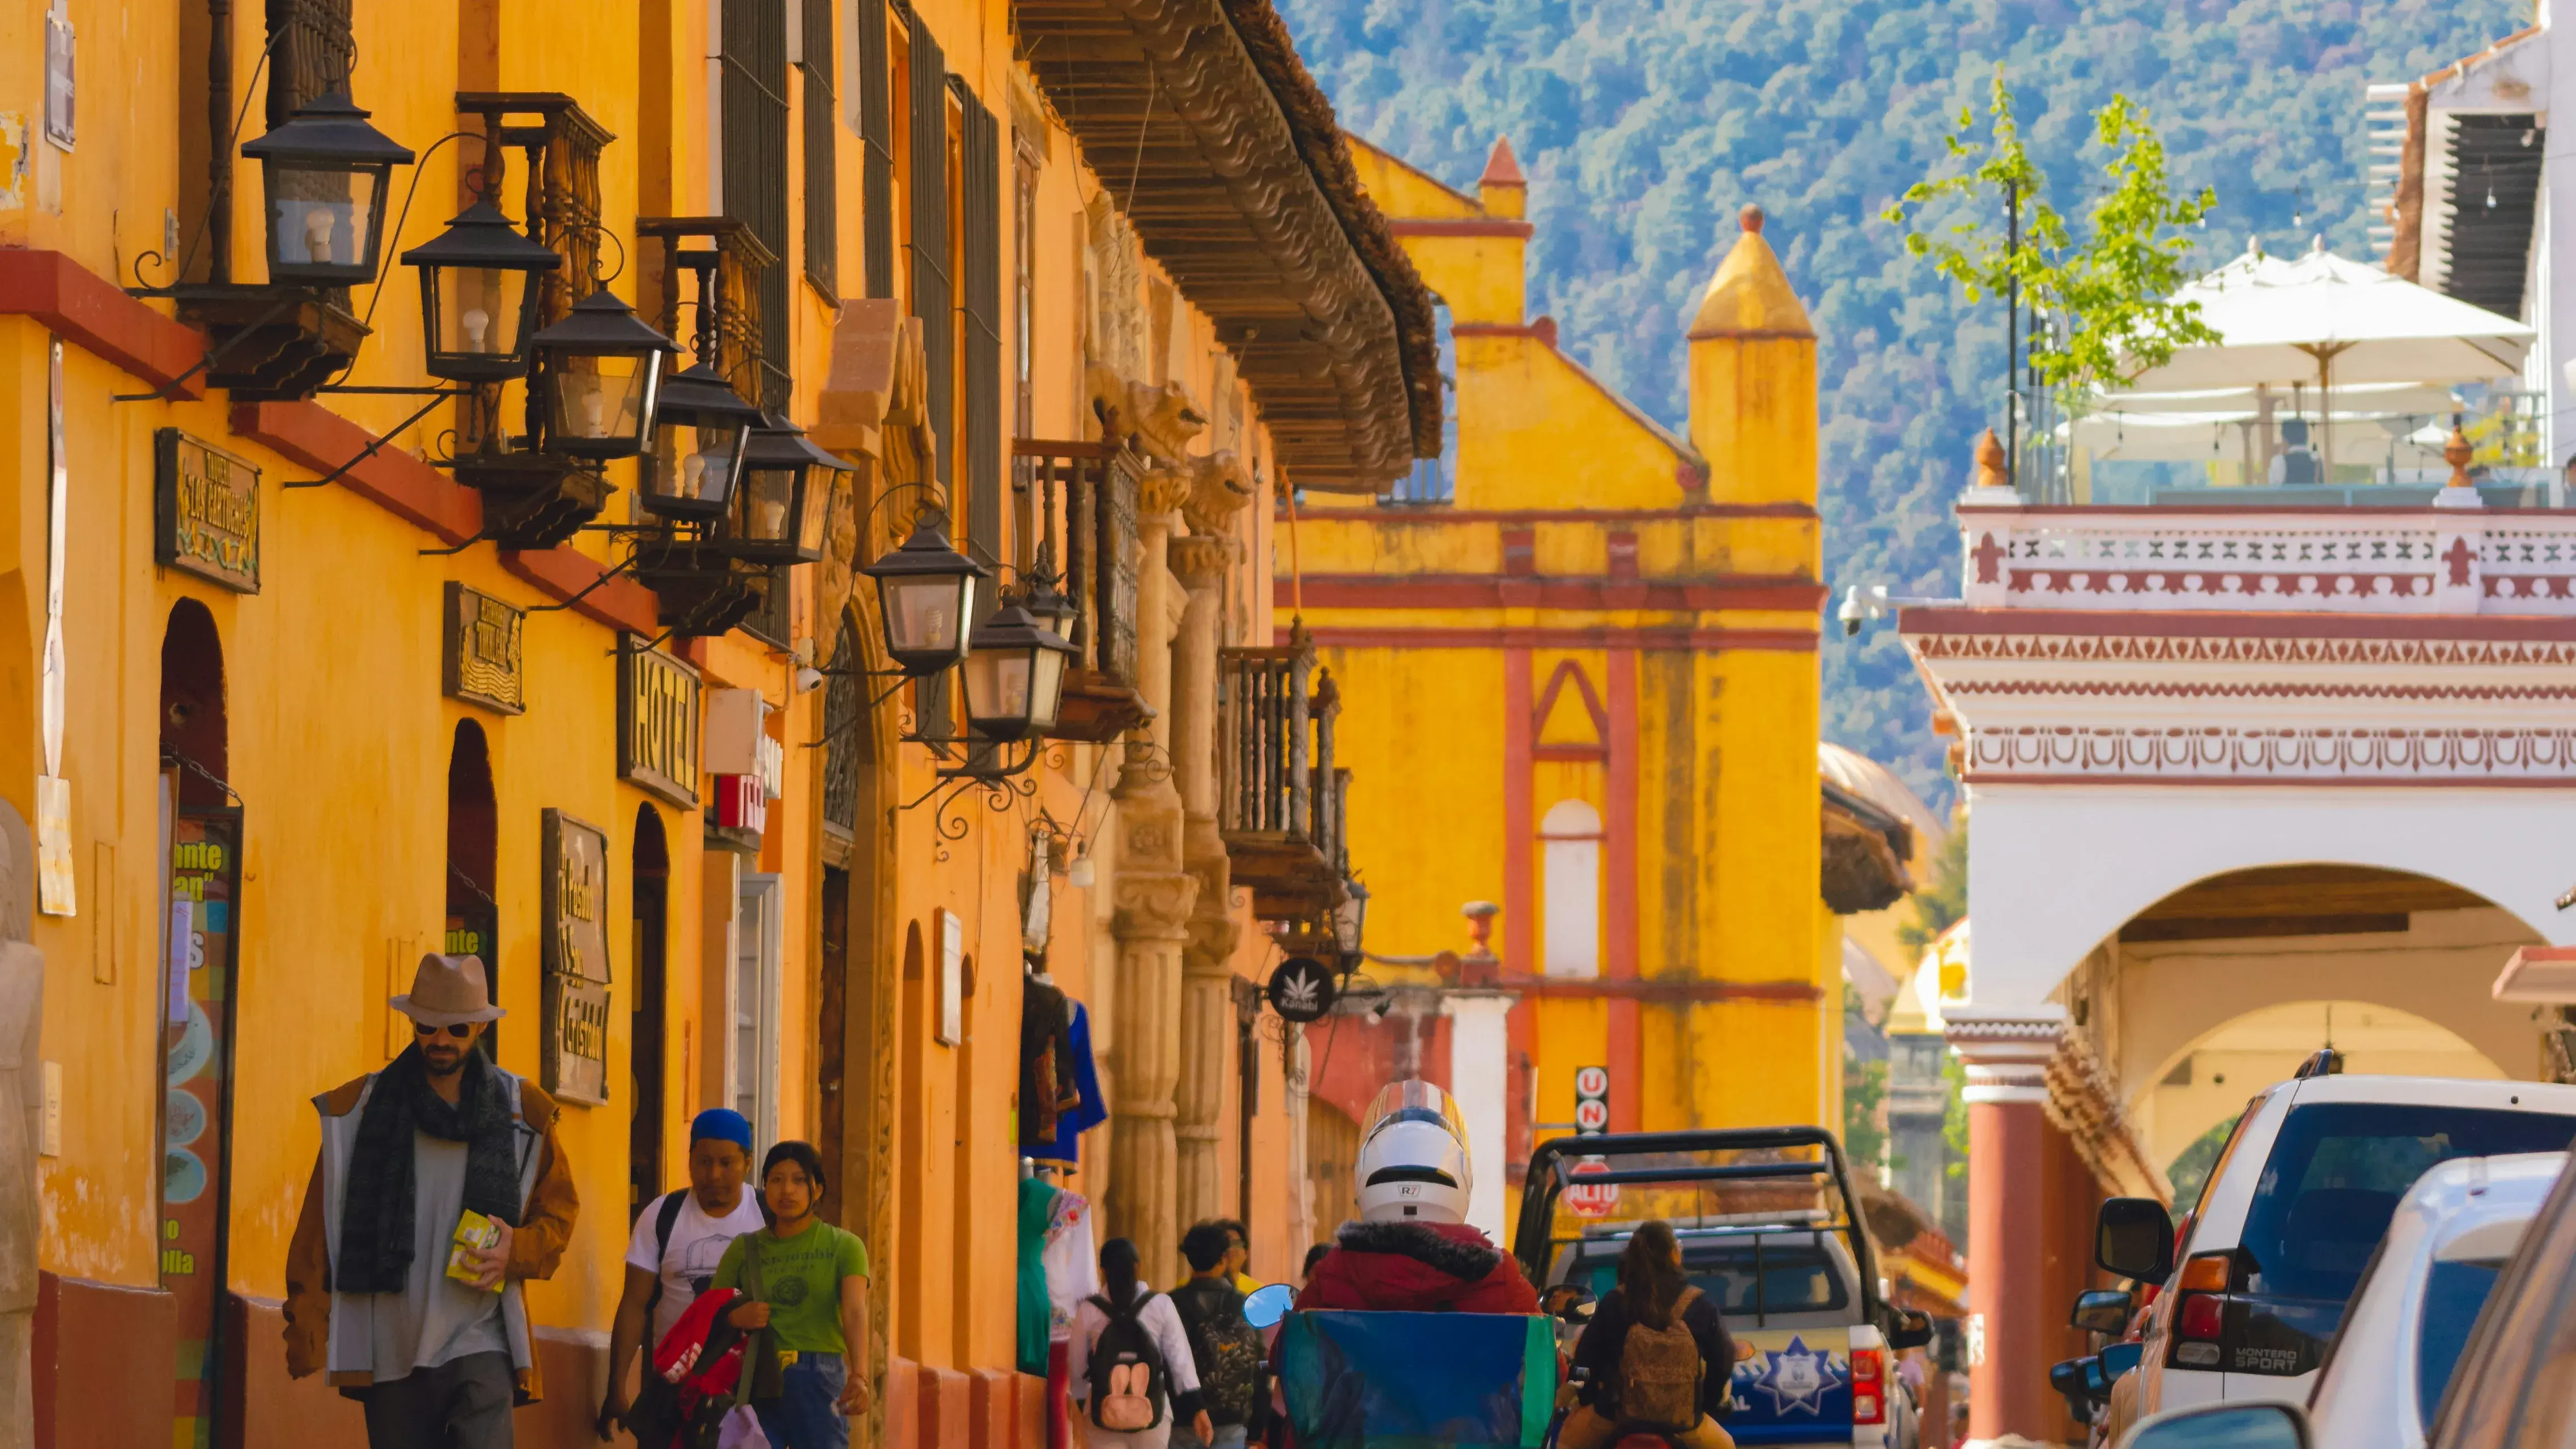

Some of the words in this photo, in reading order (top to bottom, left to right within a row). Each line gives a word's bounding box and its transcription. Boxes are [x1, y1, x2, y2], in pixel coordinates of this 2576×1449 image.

[634, 652, 695, 793] HOTEL
[2235, 1347, 2297, 1359] MONTERO
[2235, 1357, 2297, 1371] SPORT
